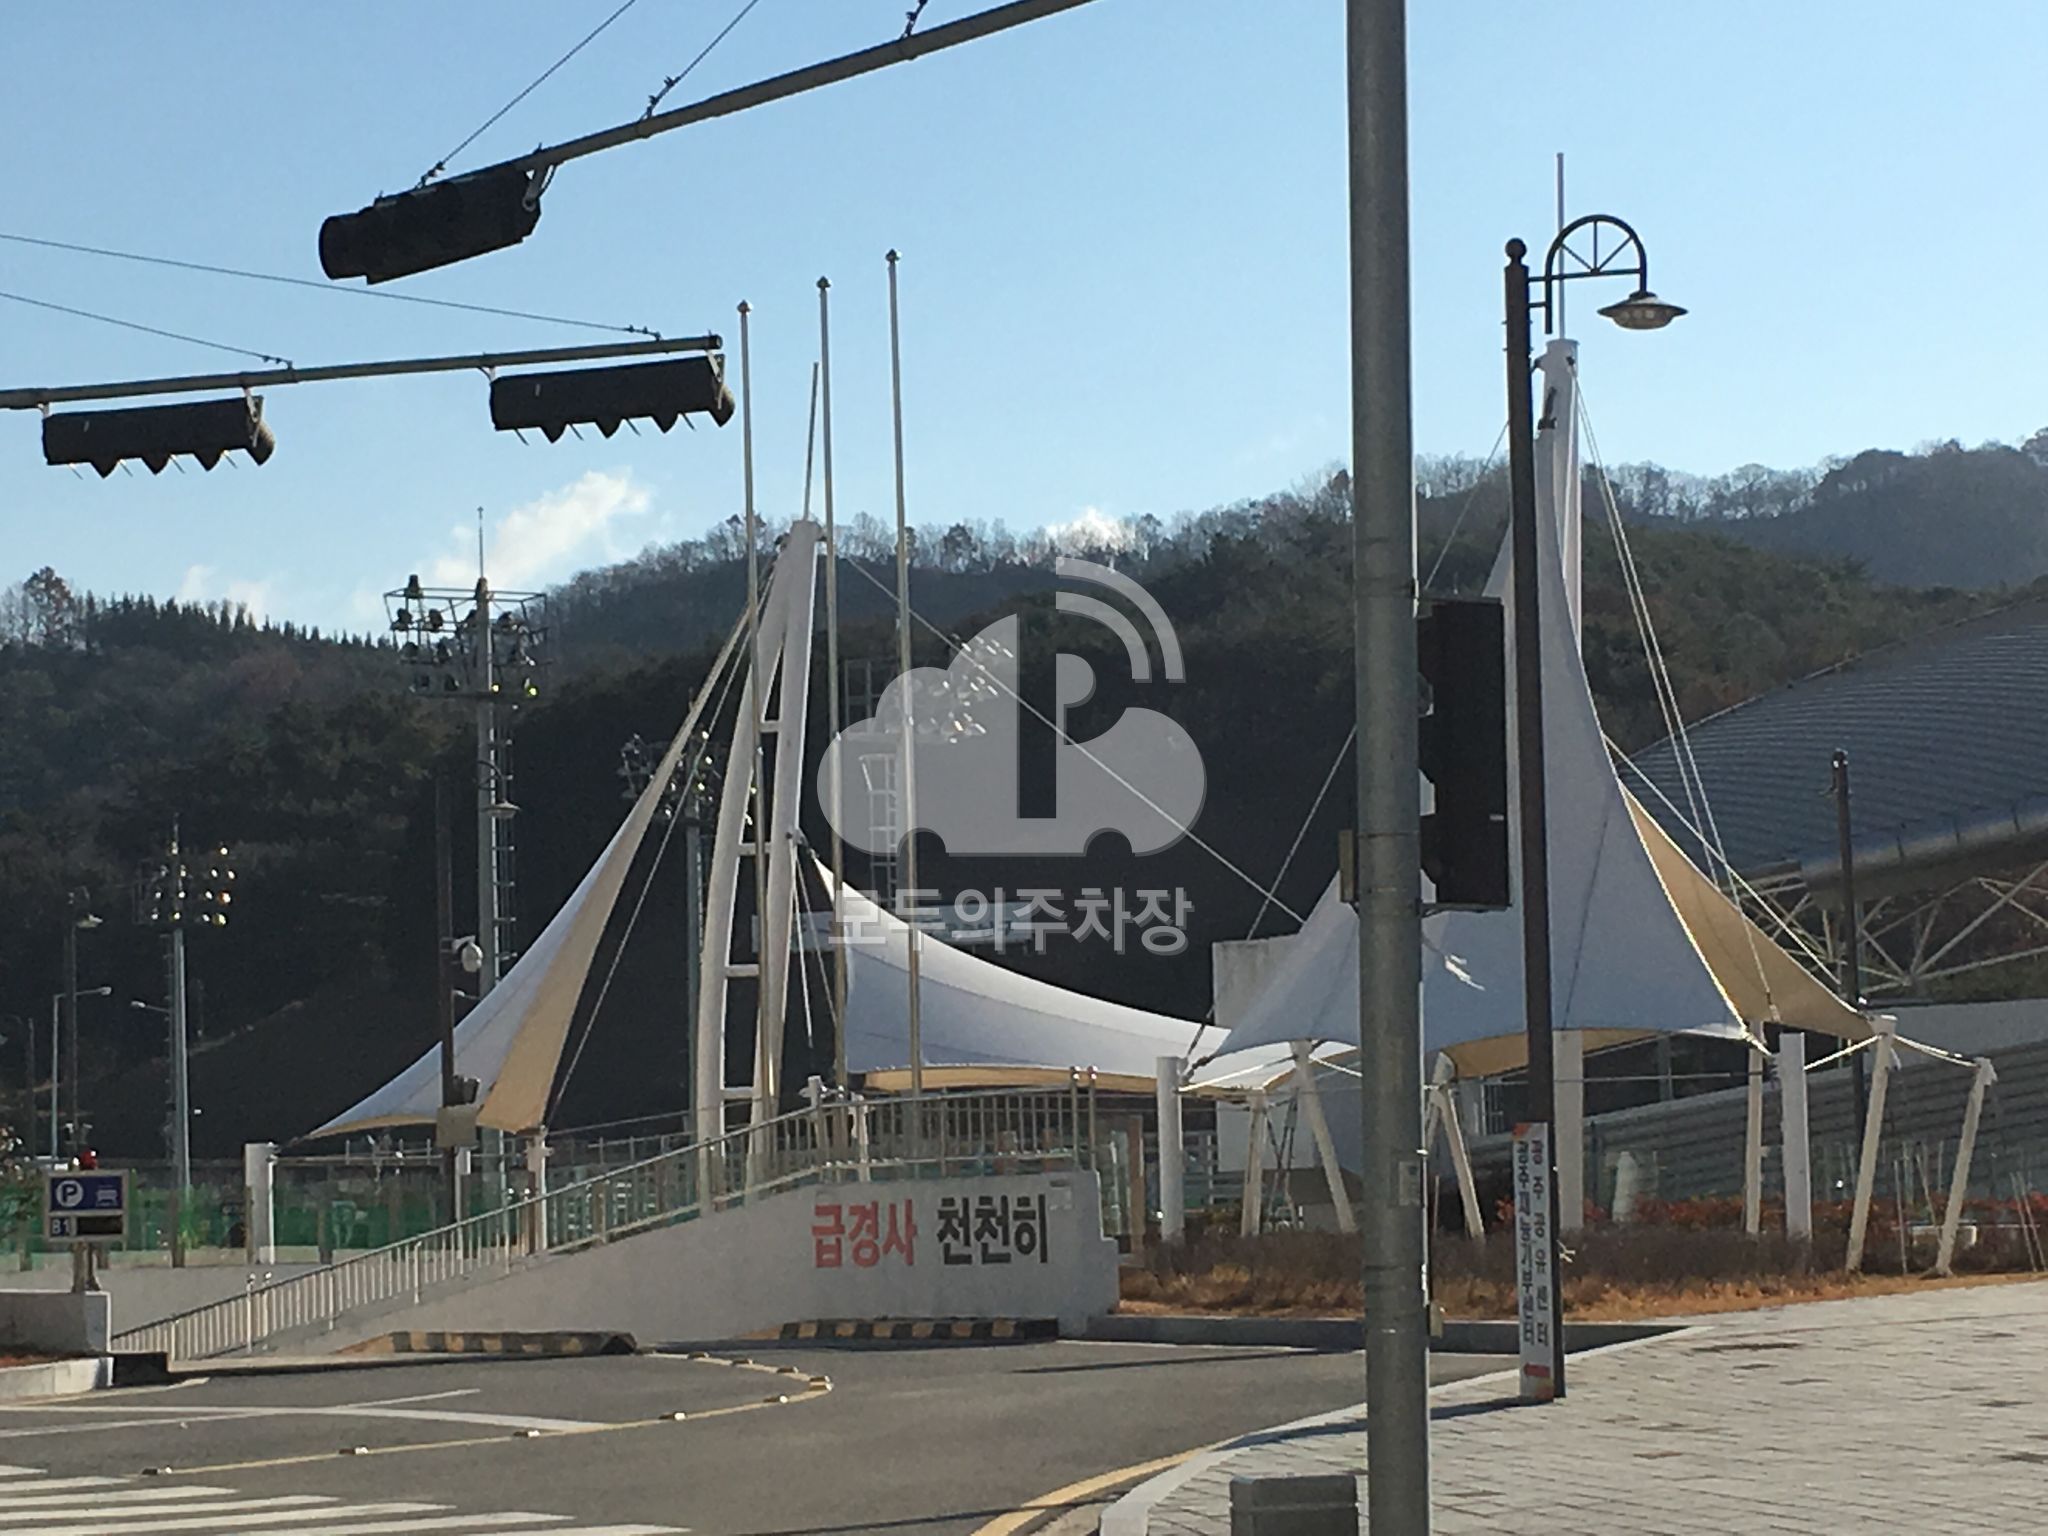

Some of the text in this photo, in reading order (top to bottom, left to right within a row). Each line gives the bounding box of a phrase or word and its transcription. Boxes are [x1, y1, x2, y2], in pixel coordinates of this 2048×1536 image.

[61, 1183, 77, 1203] P
[52, 1218, 70, 1234] B1
[812, 1194, 1048, 1268] 급경사 천천히
